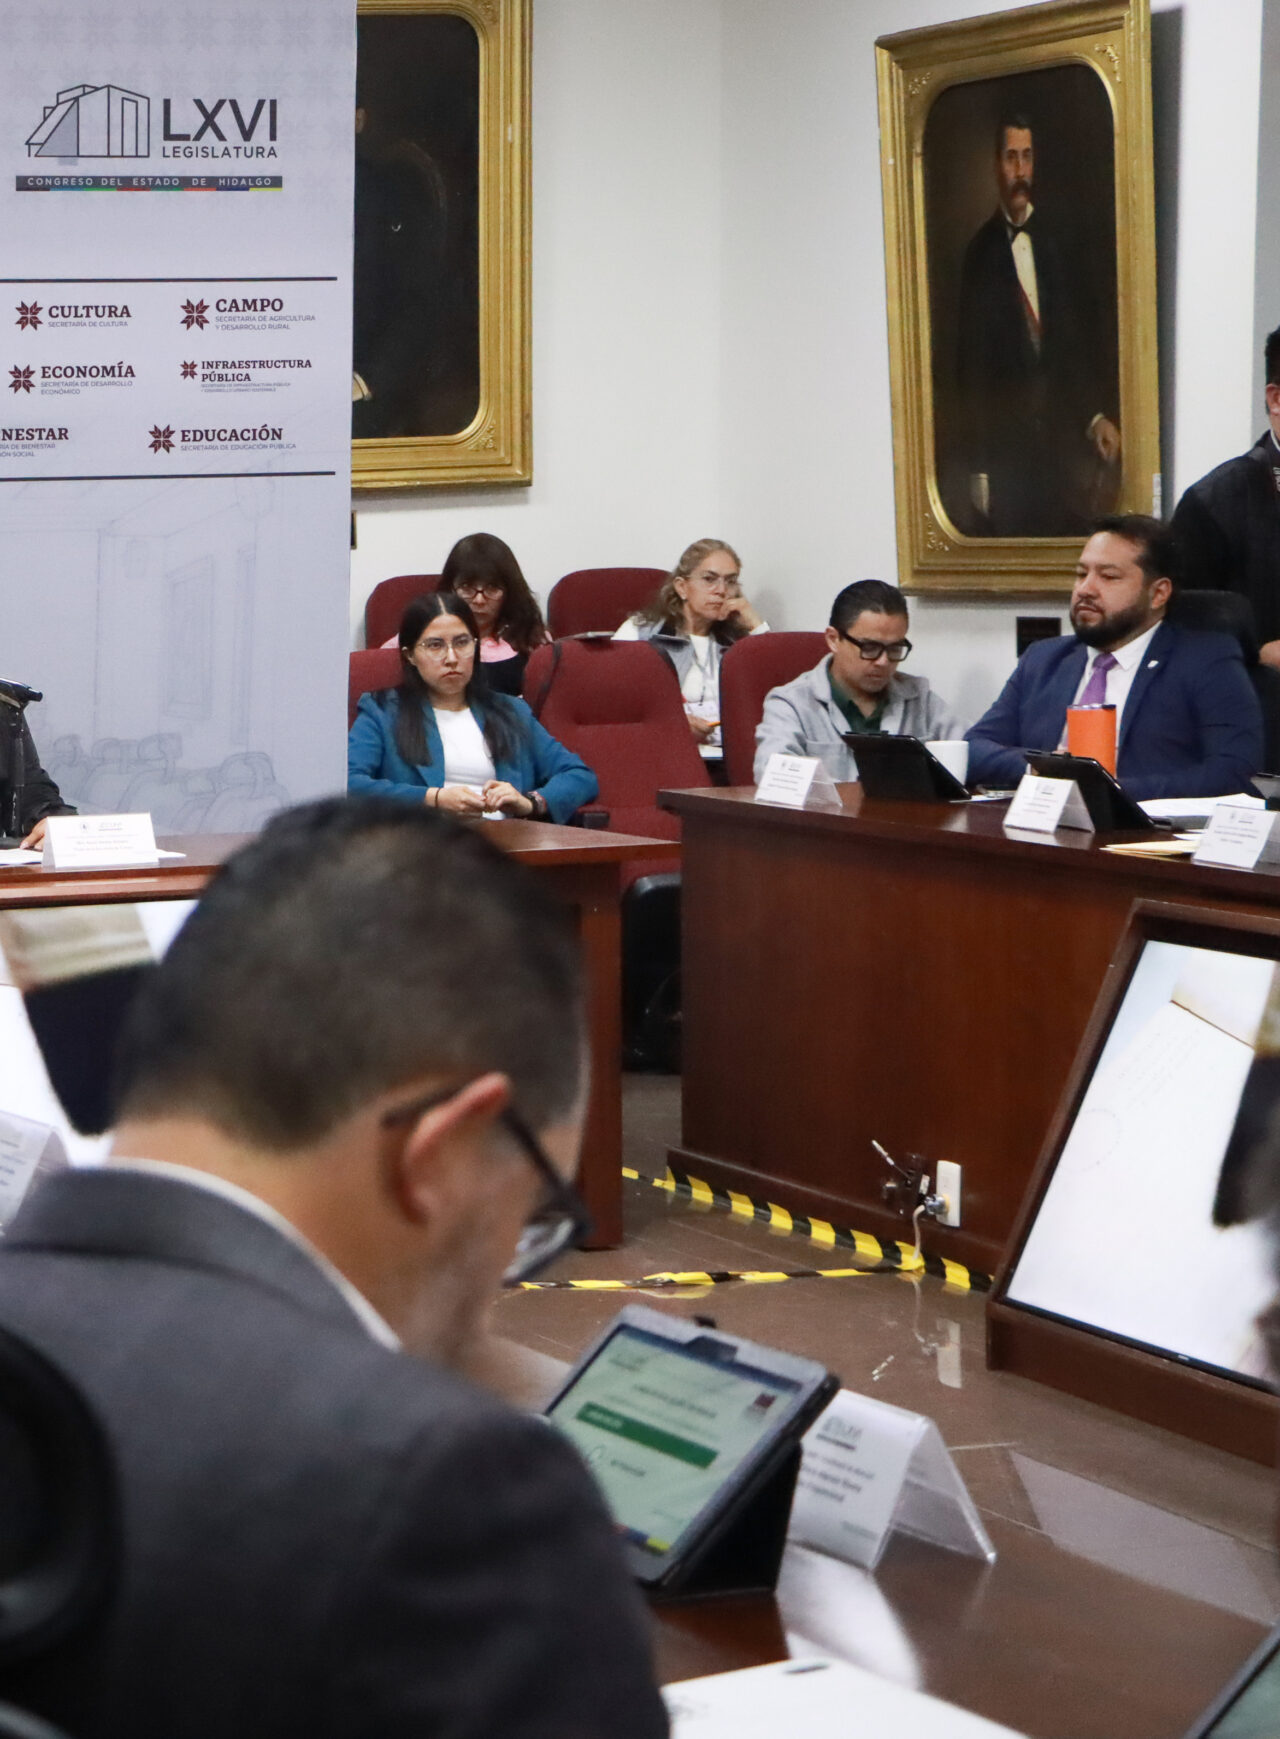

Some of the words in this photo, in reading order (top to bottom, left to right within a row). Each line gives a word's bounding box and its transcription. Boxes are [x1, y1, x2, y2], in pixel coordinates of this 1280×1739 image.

[163, 98, 278, 142] LXVI
[162, 146, 278, 159] LEGISLATURA
[27, 177, 93, 186] CONGRESO
[101, 177, 122, 186] DEL
[132, 177, 180, 186] ESTADO
[192, 177, 206, 186] DE
[218, 177, 272, 186] HIDALGO
[48, 305, 132, 318] CULTURA
[215, 298, 284, 313] CAMPO
[41, 362, 136, 379] ECONOMÍA
[202, 360, 312, 369] INFRAESTRUCTURA
[202, 371, 252, 382] PÚBLICA
[181, 424, 283, 442] EDUCACIÓN
